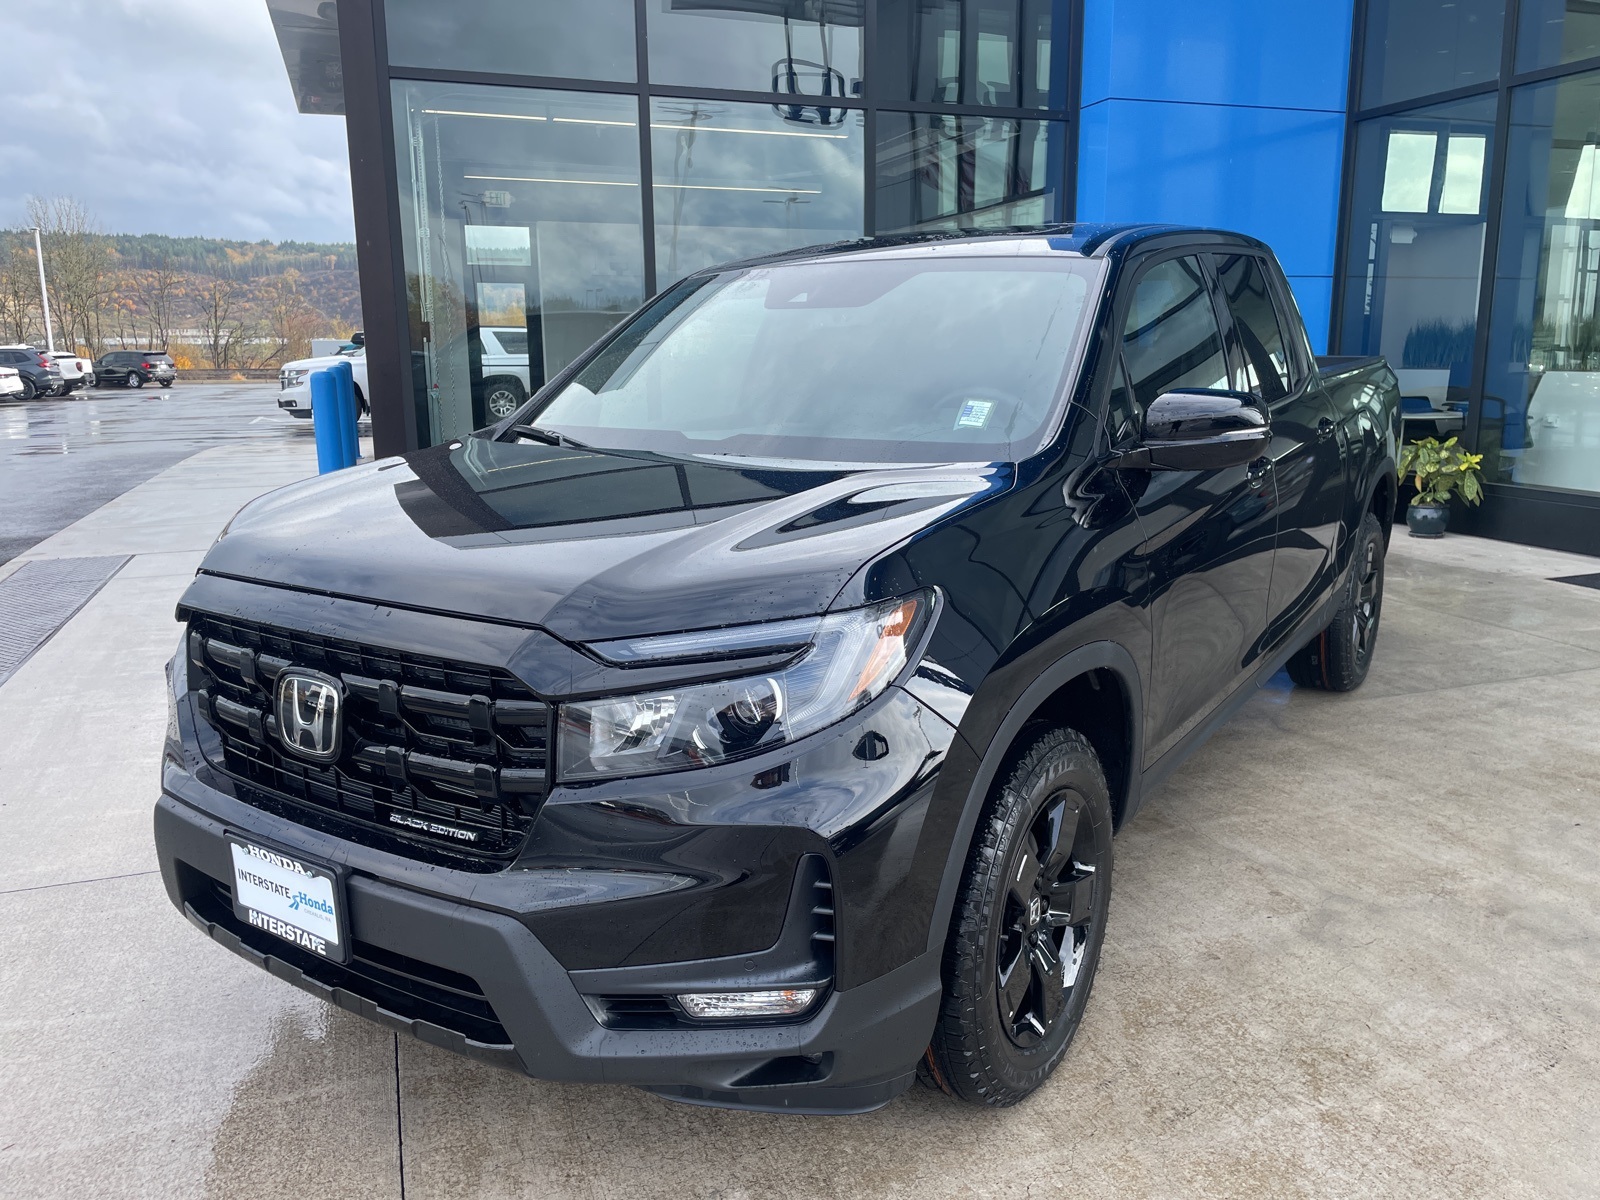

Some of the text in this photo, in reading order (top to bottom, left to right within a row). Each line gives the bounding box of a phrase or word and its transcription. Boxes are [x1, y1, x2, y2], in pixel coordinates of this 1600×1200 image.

[389, 813, 477, 842] BLACK EDITION
[247, 844, 307, 876] HONDA
[237, 868, 292, 900] INTERSTATE
[298, 891, 334, 916] Honda
[248, 909, 327, 956] INTERSTATE
